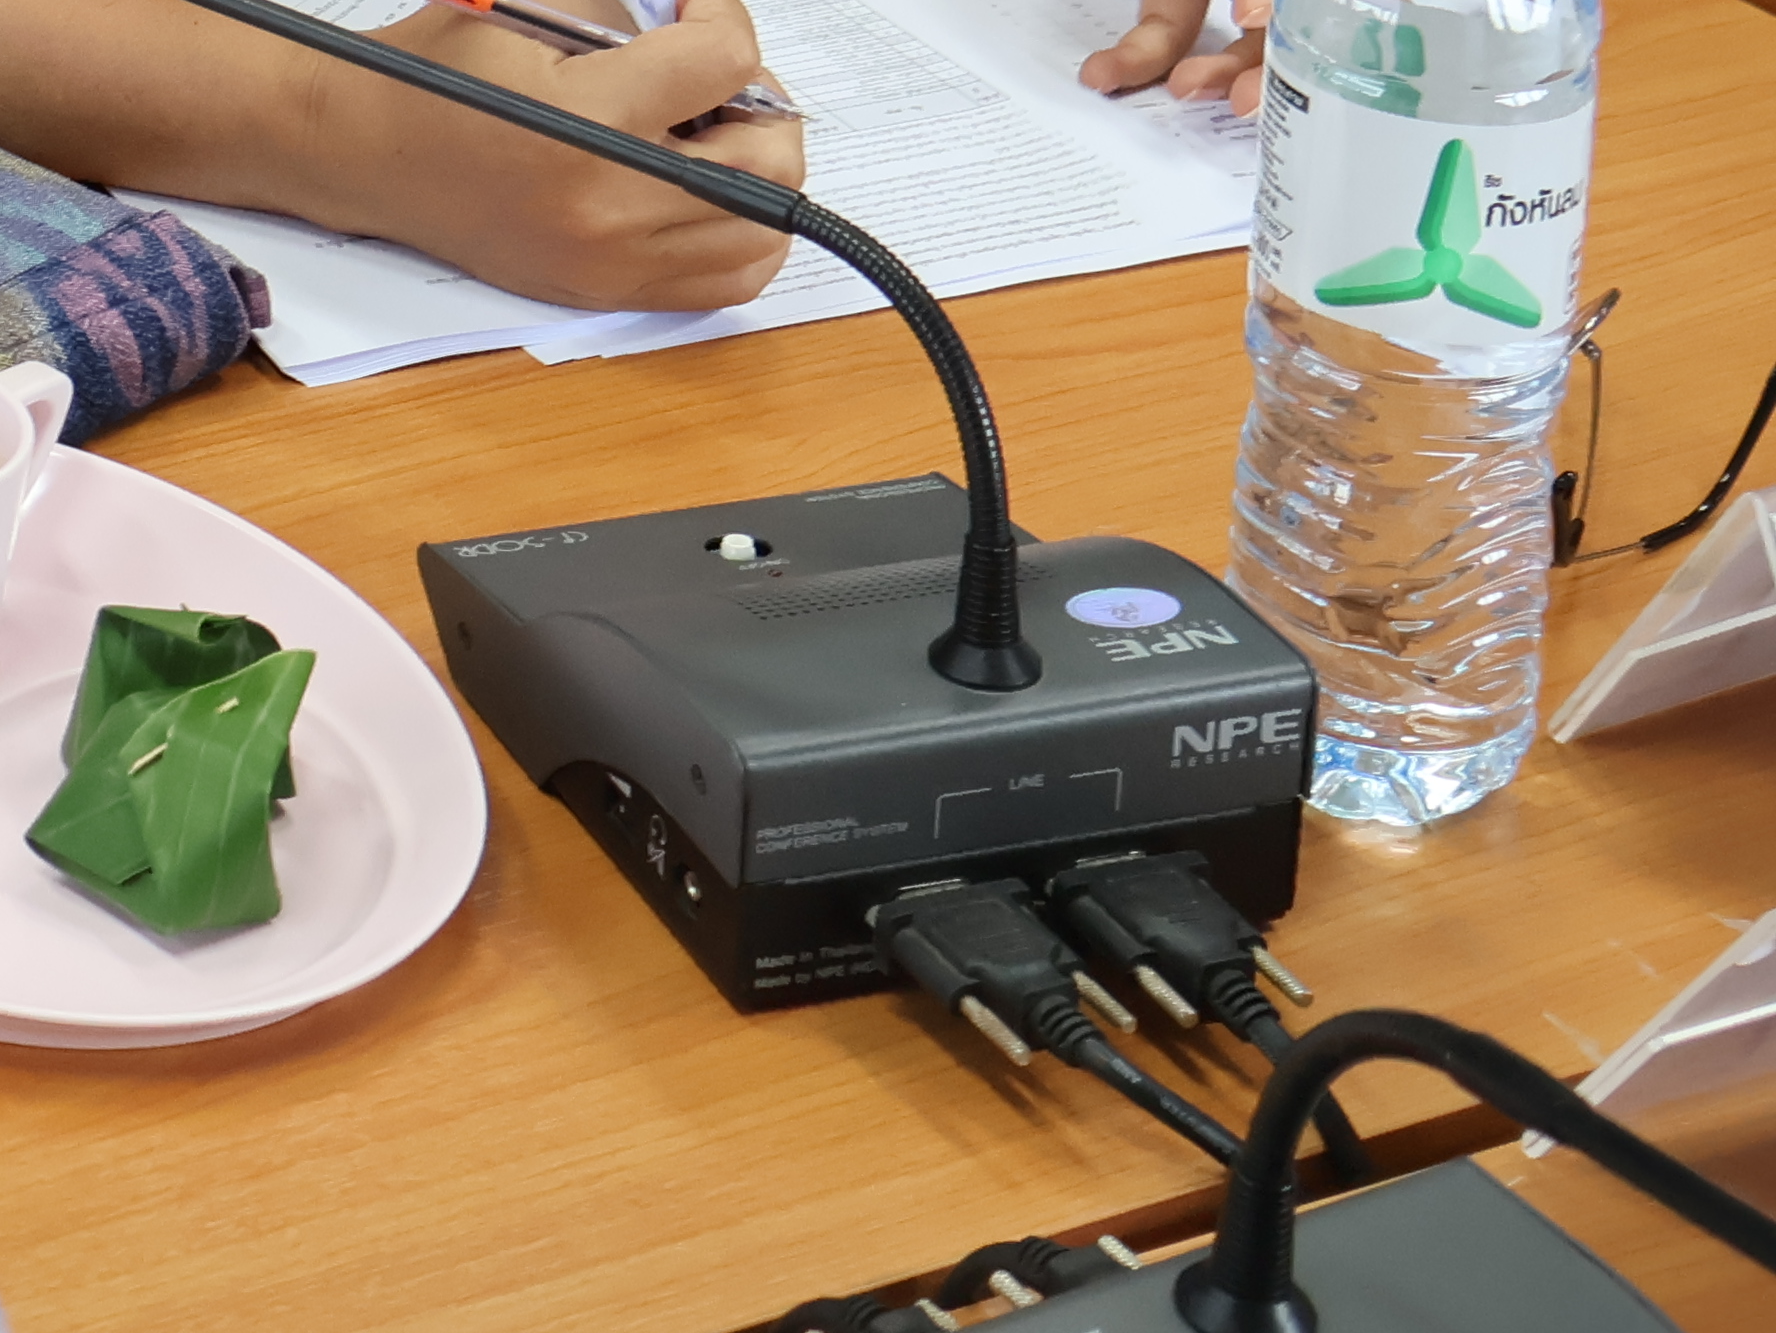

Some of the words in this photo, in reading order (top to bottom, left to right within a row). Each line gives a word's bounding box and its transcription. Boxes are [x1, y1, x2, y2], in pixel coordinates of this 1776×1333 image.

[1095, 624, 1240, 663] NPE
[1171, 708, 1303, 757] NPE
[1170, 743, 1300, 769] RESEARCH
